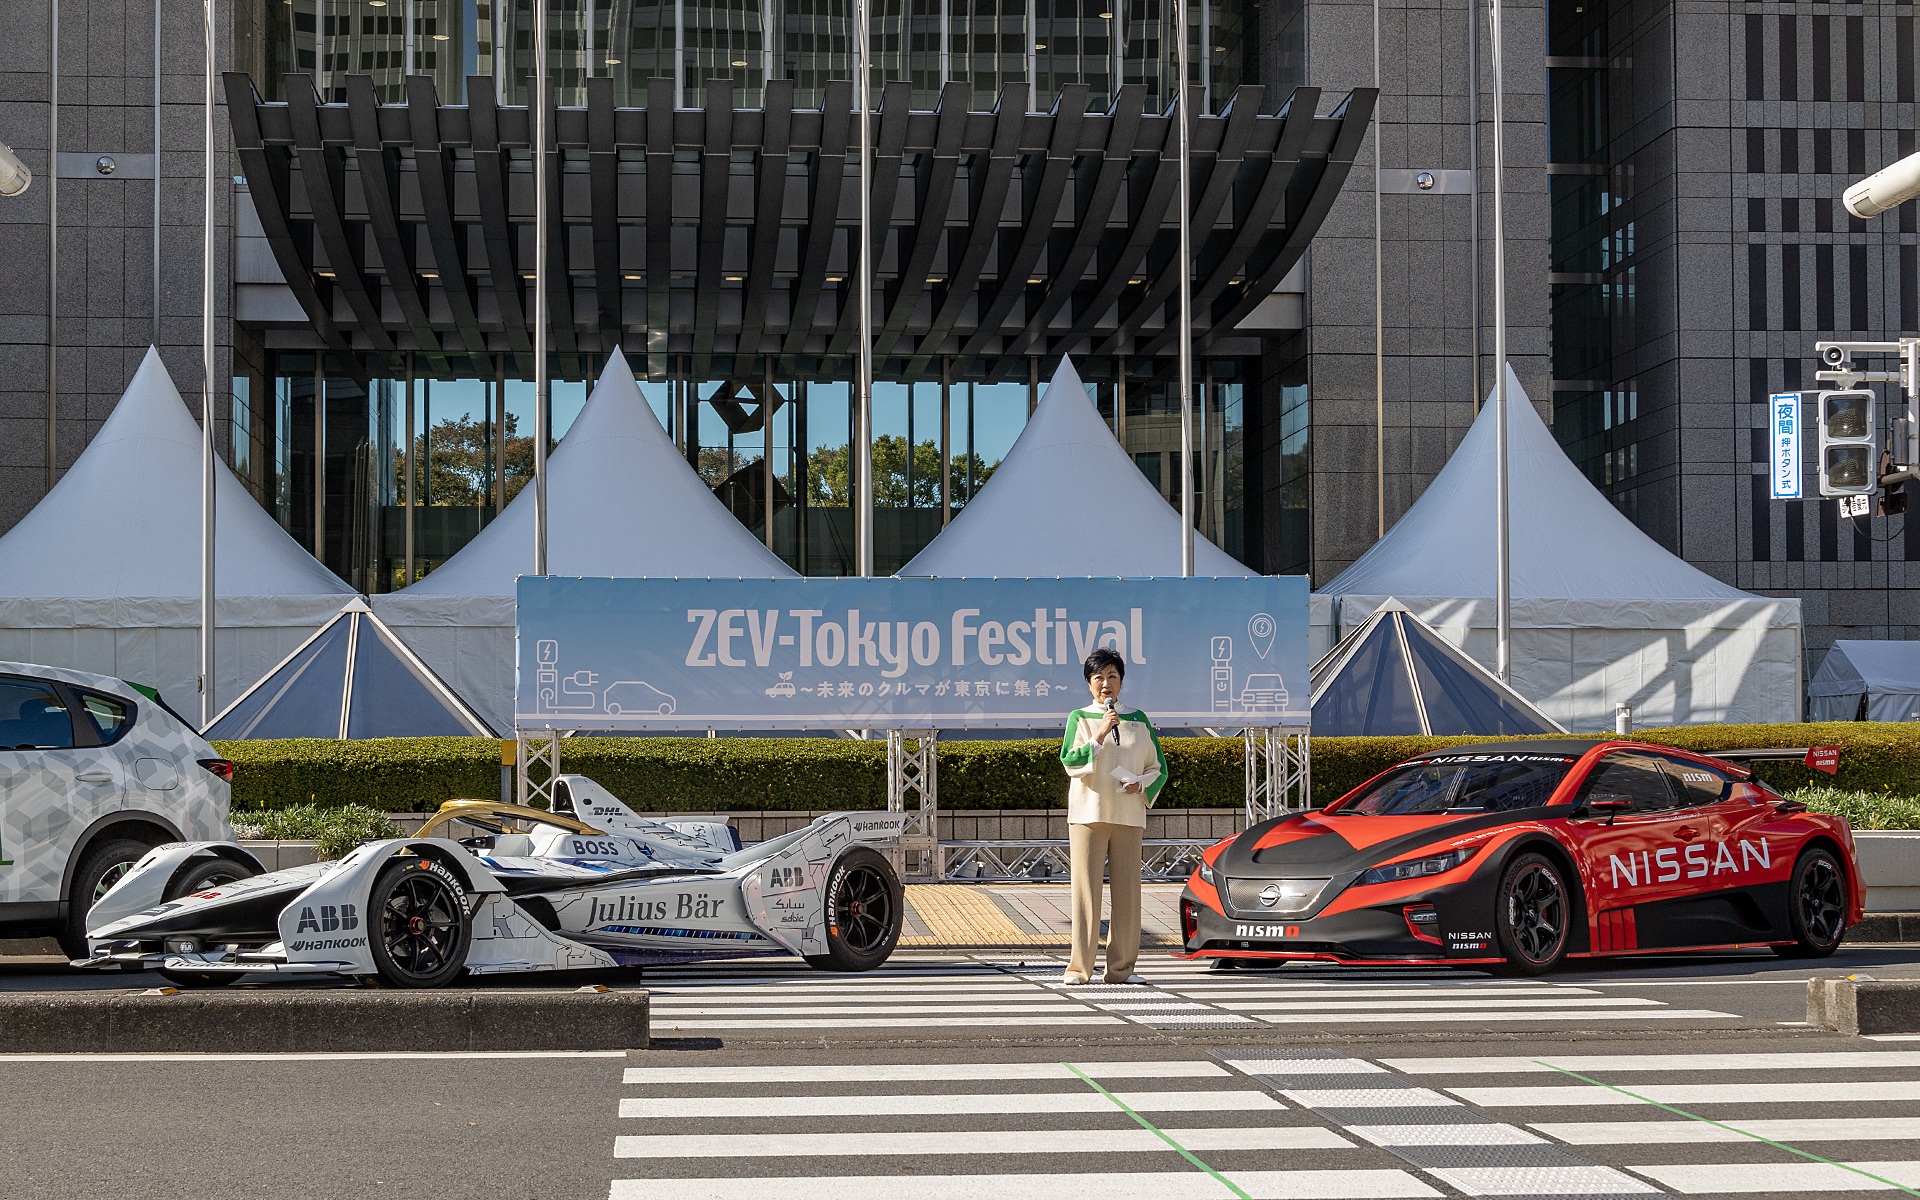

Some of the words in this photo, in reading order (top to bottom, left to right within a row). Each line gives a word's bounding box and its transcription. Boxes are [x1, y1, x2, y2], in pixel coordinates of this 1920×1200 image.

[1777, 403, 1794, 435] 夜間
[1781, 437, 1792, 489] 押ボタン式
[685, 609, 941, 678] ZEV-Tokyo
[951, 608, 1147, 666] Festival
[1429, 755, 1528, 764] NISSAN
[593, 807, 623, 816] DHL
[573, 840, 619, 855] BOSS
[770, 867, 804, 888] ABB
[1609, 837, 1771, 889] NISSAN
[296, 904, 358, 933] ABB
[586, 895, 667, 927] Julius
[675, 893, 724, 919] Bär
[1236, 925, 1300, 937] nismo
